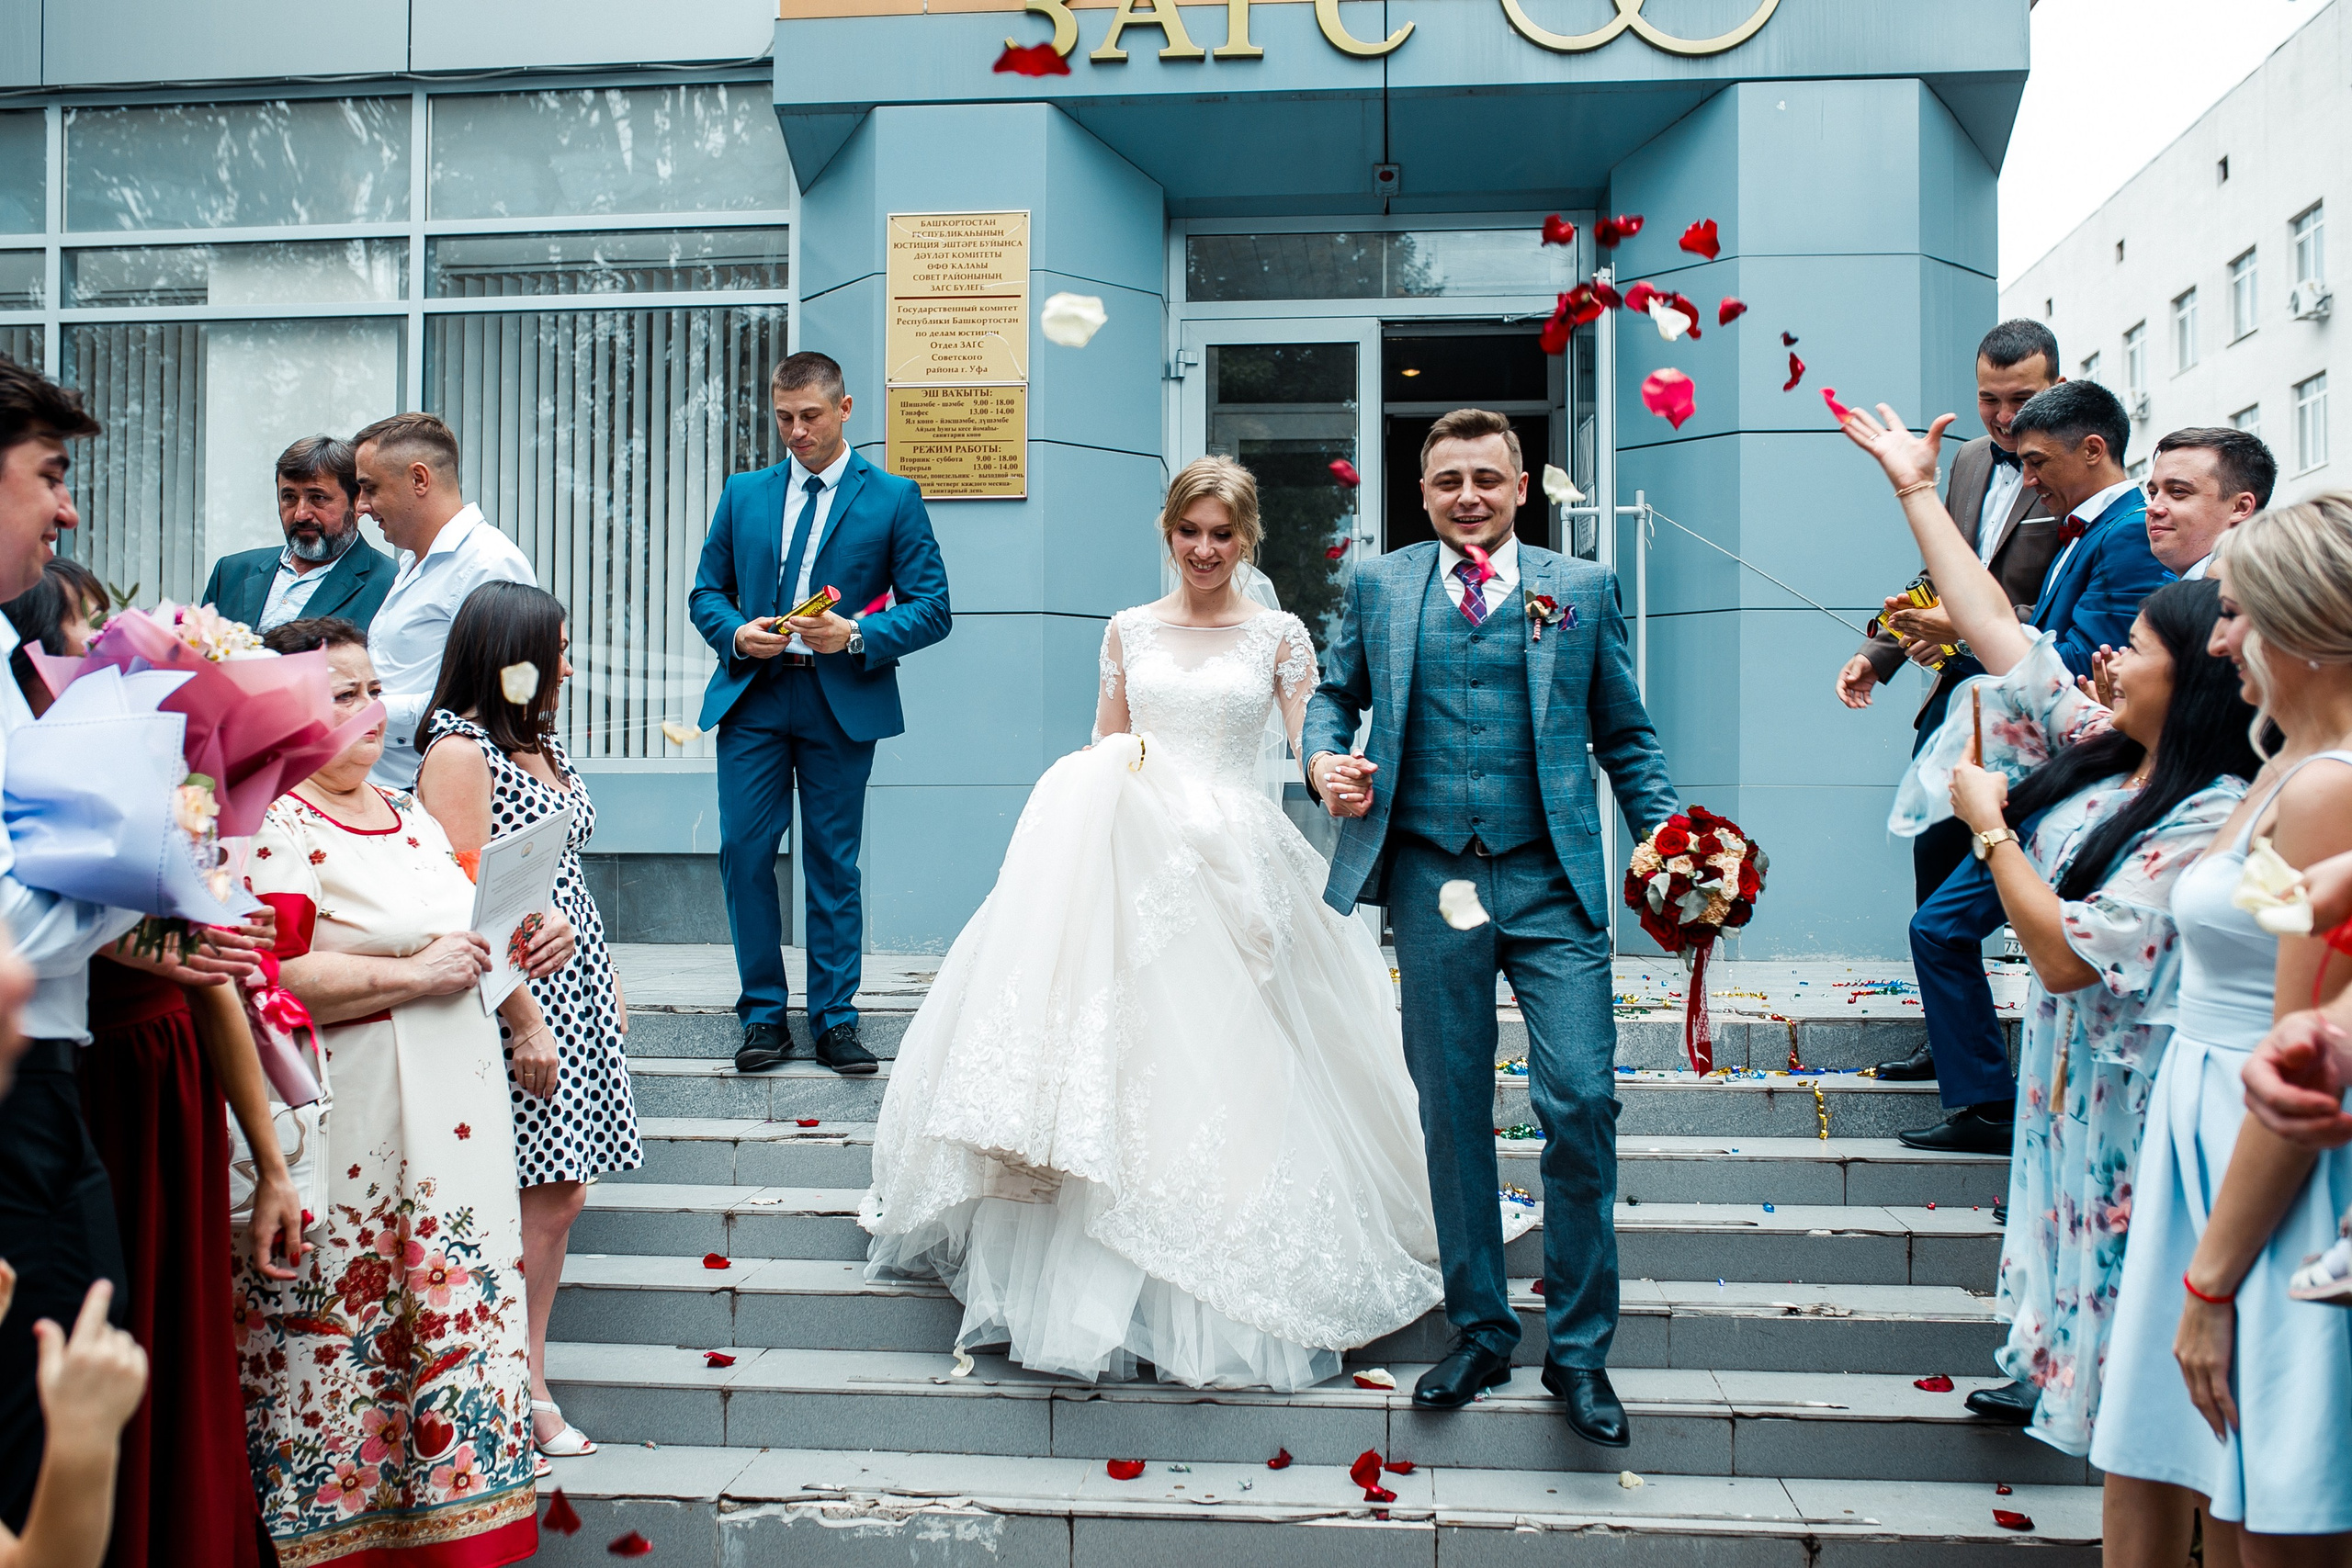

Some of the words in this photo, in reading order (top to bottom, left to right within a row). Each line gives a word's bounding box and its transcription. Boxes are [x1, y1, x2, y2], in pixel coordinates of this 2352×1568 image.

[979, 239, 1023, 248] БУЙЫНСА
[952, 251, 1002, 259] КОМИТЕТЫ
[898, 305, 978, 315] Государственный
[896, 317, 950, 327] Республики
[952, 317, 1019, 326] Башкортостан
[926, 366, 959, 376] района
[969, 366, 988, 375] Уфа
[922, 389, 939, 398] ЭШ
[912, 446, 953, 454] РЕЖИМ
[955, 445, 1001, 453] РАБОТЫ:
[2005, 942, 2024, 953] 73
